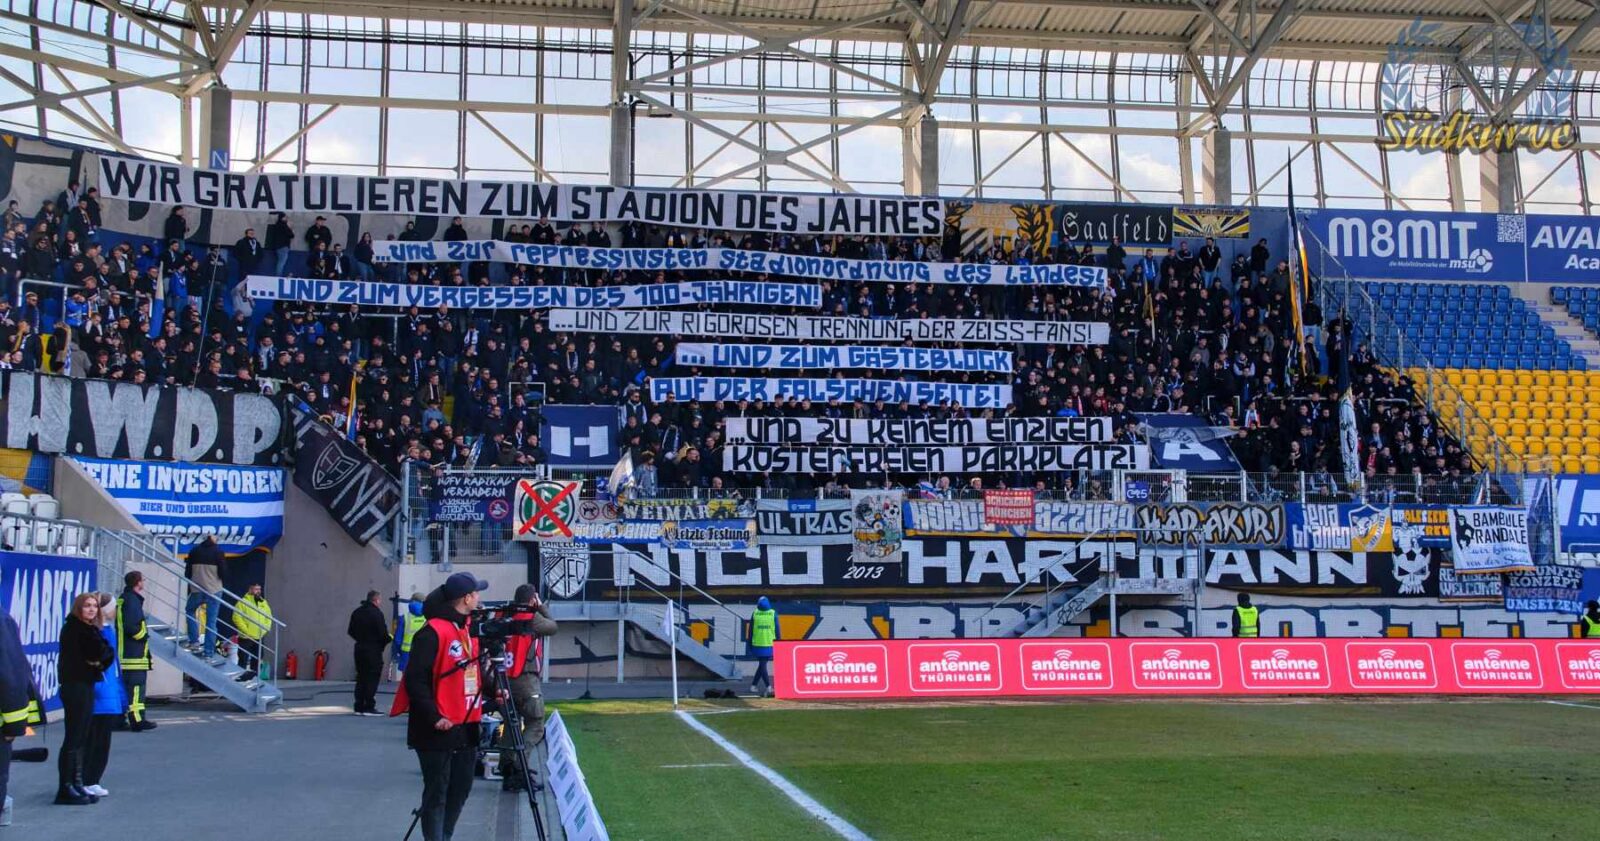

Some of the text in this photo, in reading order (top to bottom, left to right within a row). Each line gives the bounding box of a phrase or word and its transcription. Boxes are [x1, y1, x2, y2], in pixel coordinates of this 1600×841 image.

[213, 152, 227, 168] N
[101, 158, 940, 234] WIR GRATULIEREN ZUM STADION DES JAHRES
[1063, 212, 1167, 243] Saalfeld
[448, 241, 495, 260] zur
[511, 245, 708, 267] repressivsten
[944, 264, 991, 284] des
[1449, 259, 1476, 269] msu
[339, 282, 399, 304] ZUM
[406, 286, 567, 307] VERGESSEN
[575, 286, 625, 307] DES
[634, 281, 819, 306] 100-JÄHRIGEN!
[625, 311, 671, 332] ZUR
[682, 313, 798, 336] RIGOROSEN
[807, 317, 912, 339] TRENNUNG
[918, 321, 954, 339] DER
[962, 321, 1092, 343] ZEISS-FANS!
[780, 347, 840, 367] ZUM
[848, 347, 1010, 371] GÄSTEBLOCK
[654, 378, 1000, 407] AUF DER FALSCHEN SEITE!
[148, 465, 283, 493] INVESTOREN
[140, 502, 228, 514] HIER UND ÜBERALL
[758, 511, 853, 535] ULTRAS
[1473, 512, 1525, 528] BAMBULE
[1475, 529, 1527, 545] RANDALE
[613, 543, 823, 586] NICO
[842, 566, 885, 579] 2013
[1440, 582, 1502, 596] WELCOME
[1509, 576, 1580, 589] KONZEPT
[1508, 587, 1580, 599] KONSEQUENT
[1506, 598, 1583, 613] UMSETZEN
[804, 660, 877, 673] antenne
[919, 659, 990, 672] antenne
[1031, 658, 1101, 671] antenne
[1141, 658, 1210, 671] antenne
[1250, 658, 1318, 670] antenne
[1357, 658, 1424, 670] antenne
[1464, 658, 1530, 670] antenne
[805, 674, 878, 684] THÜRINGEN
[920, 672, 991, 683] THÜRINGEN
[1032, 671, 1103, 682] THÜRINGEN
[1142, 671, 1212, 681] THÜRINGEN
[1251, 671, 1320, 681] THÜRINGEN
[1358, 671, 1427, 681] THÜRINGEN
[1464, 671, 1533, 681] THÜRINGEN
